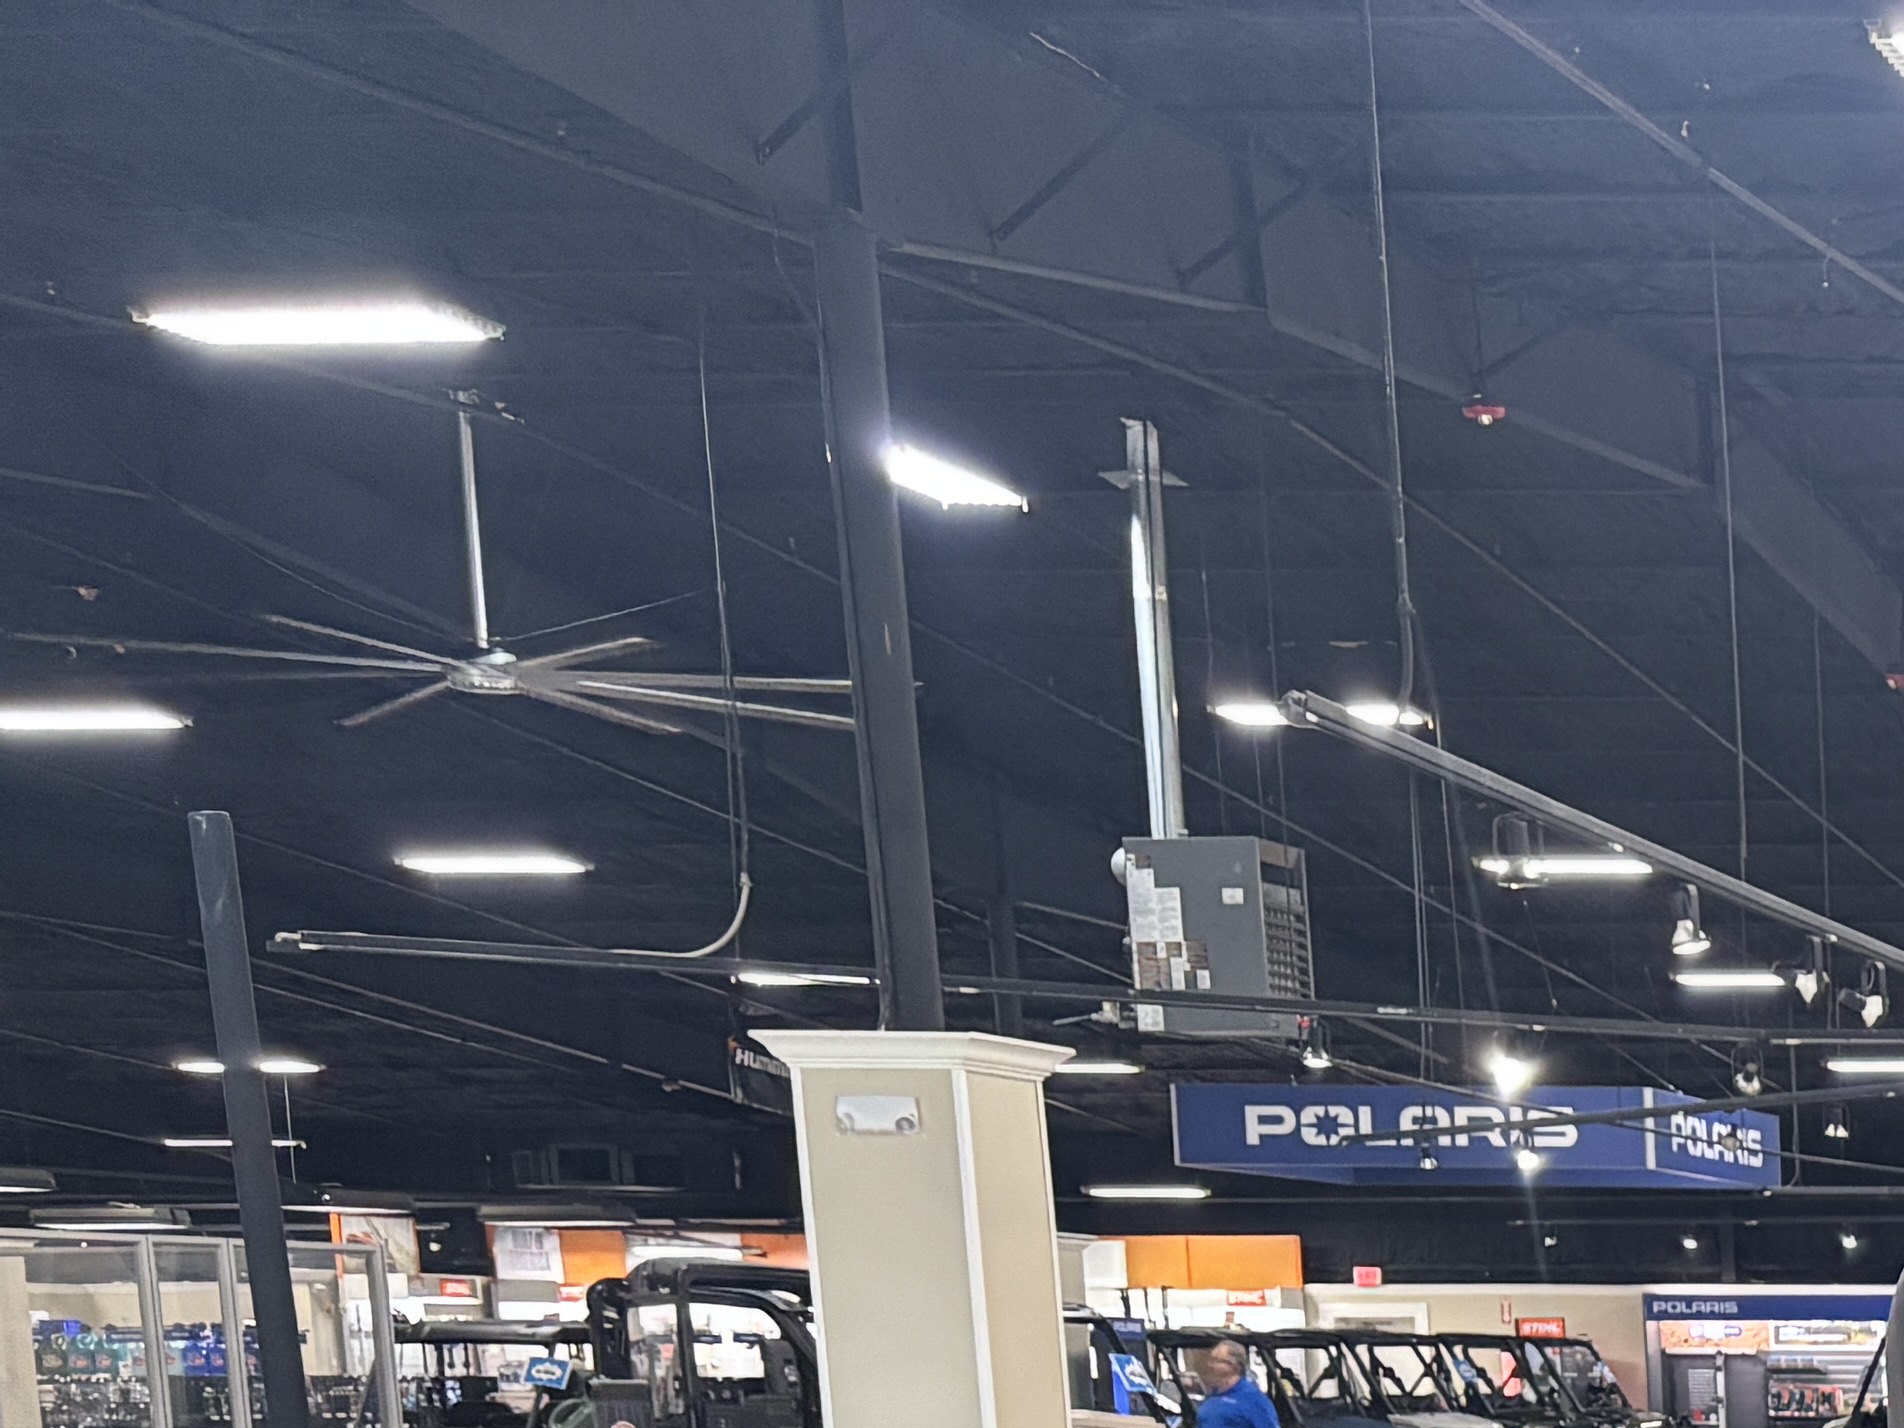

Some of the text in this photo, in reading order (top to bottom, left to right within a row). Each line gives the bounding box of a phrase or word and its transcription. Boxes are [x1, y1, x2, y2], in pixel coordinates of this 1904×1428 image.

[1243, 1105, 1579, 1148] POLARIS
[1669, 1109, 1764, 1169] POLARIS
[1652, 1301, 1739, 1314] POLARIS
